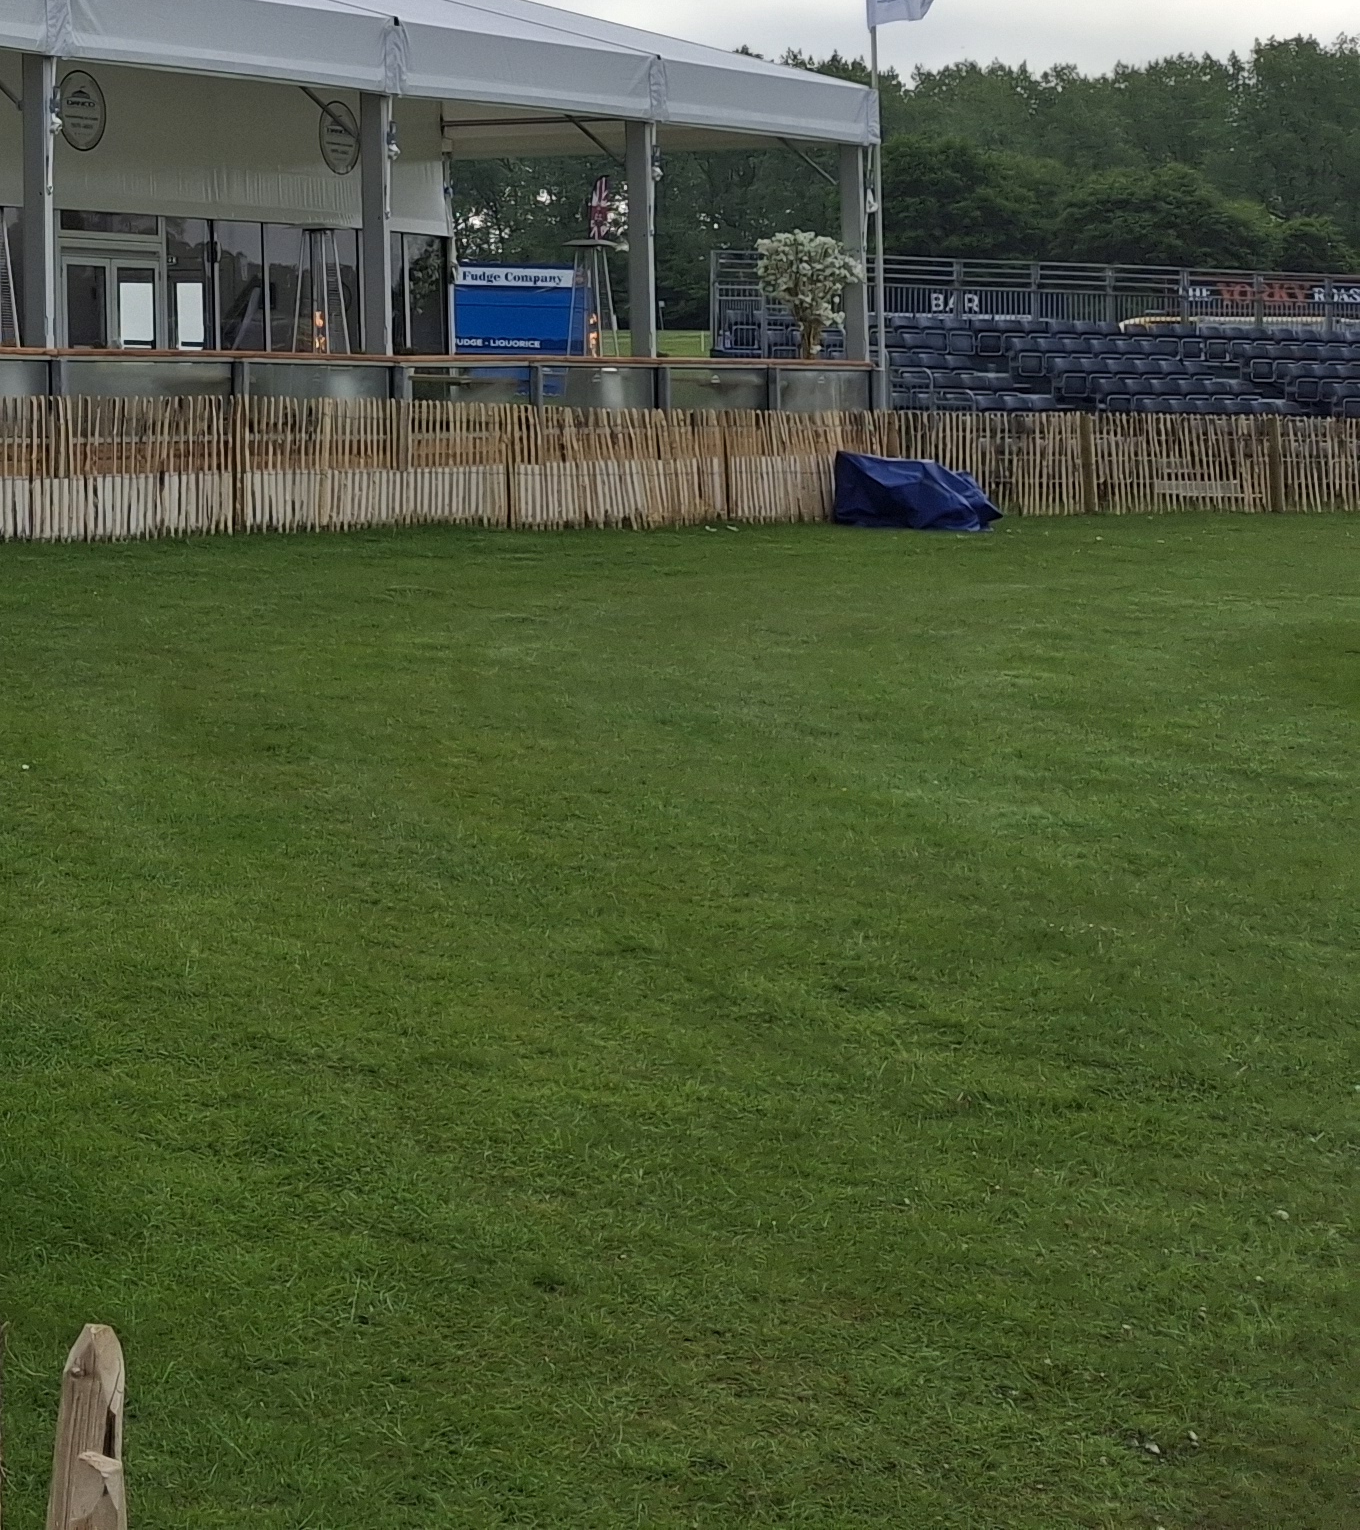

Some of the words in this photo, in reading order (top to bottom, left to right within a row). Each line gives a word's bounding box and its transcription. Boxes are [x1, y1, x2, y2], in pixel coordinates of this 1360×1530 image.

[462, 271, 501, 283] Fudge
[505, 272, 563, 285] Company
[455, 338, 483, 347] UDGE
[490, 339, 541, 349] LIQUORICE
